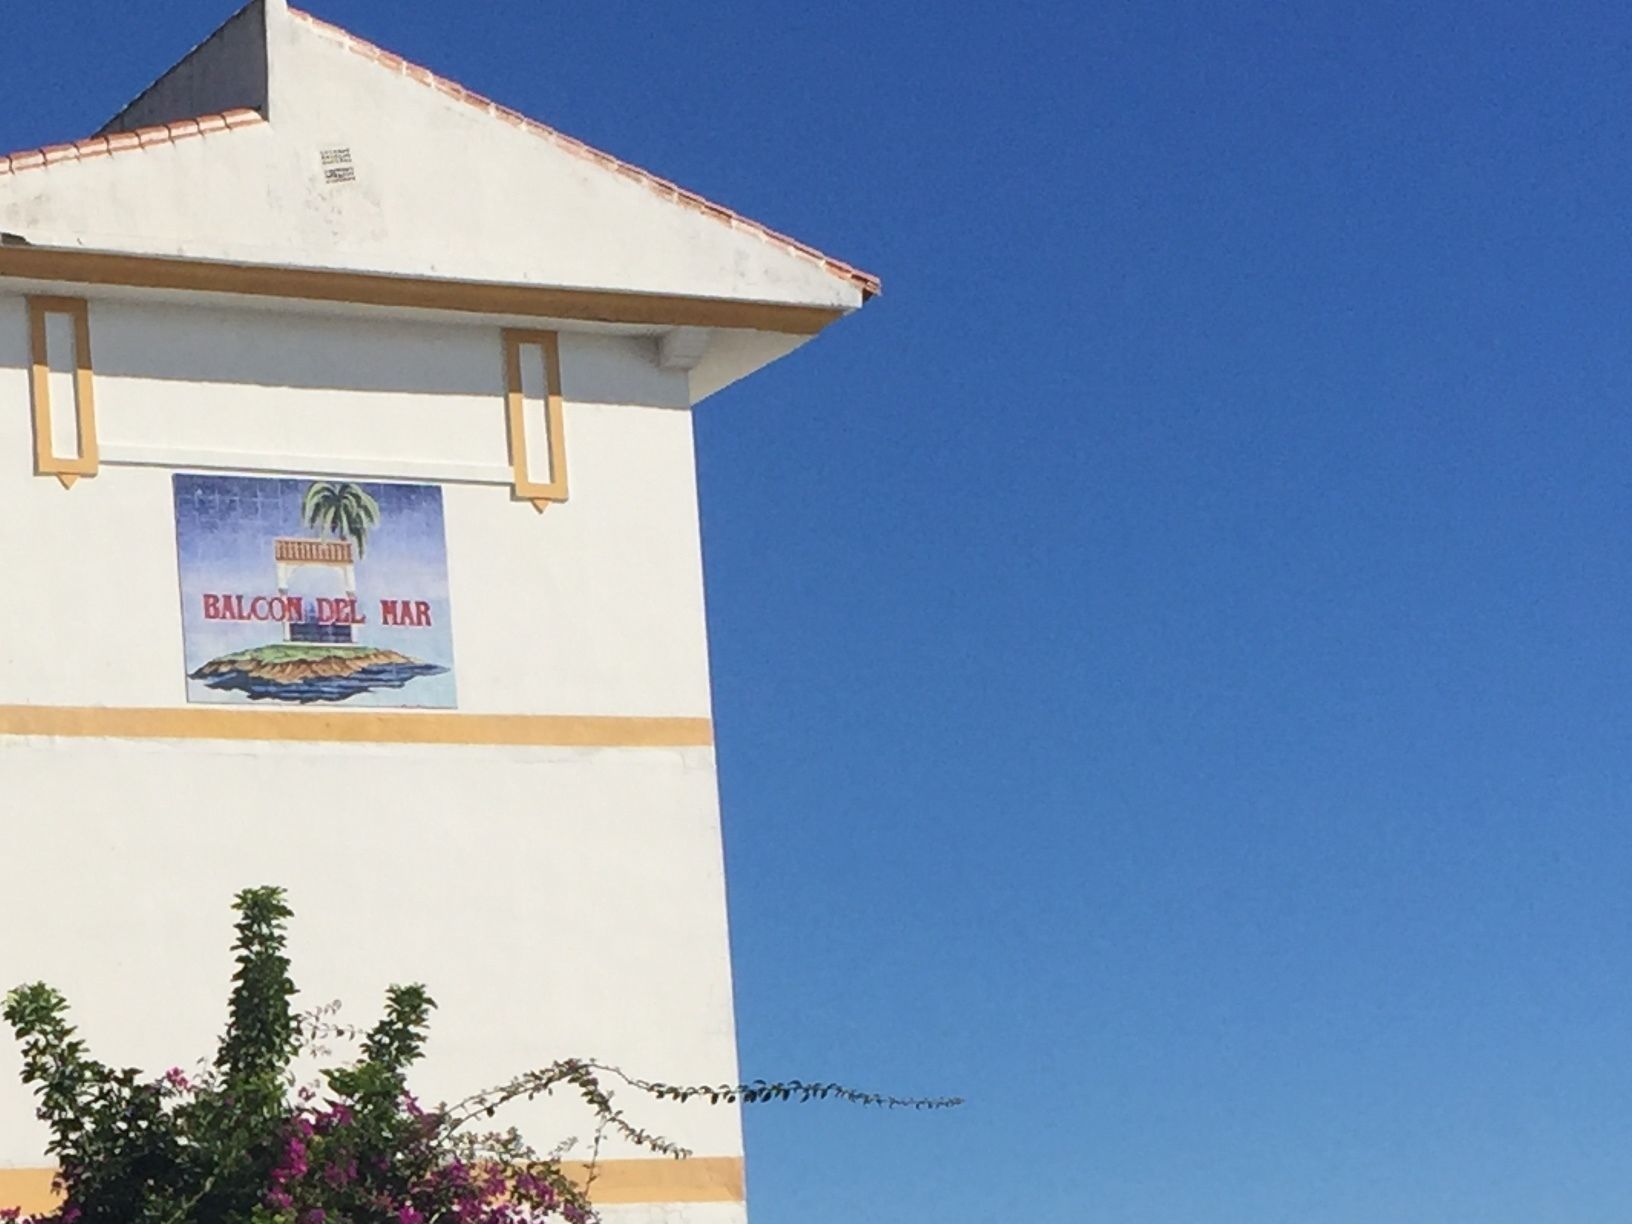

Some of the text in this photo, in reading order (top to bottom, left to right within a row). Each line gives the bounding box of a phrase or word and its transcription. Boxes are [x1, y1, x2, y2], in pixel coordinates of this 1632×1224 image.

[202, 593, 432, 627] BALCON DEL MAR
